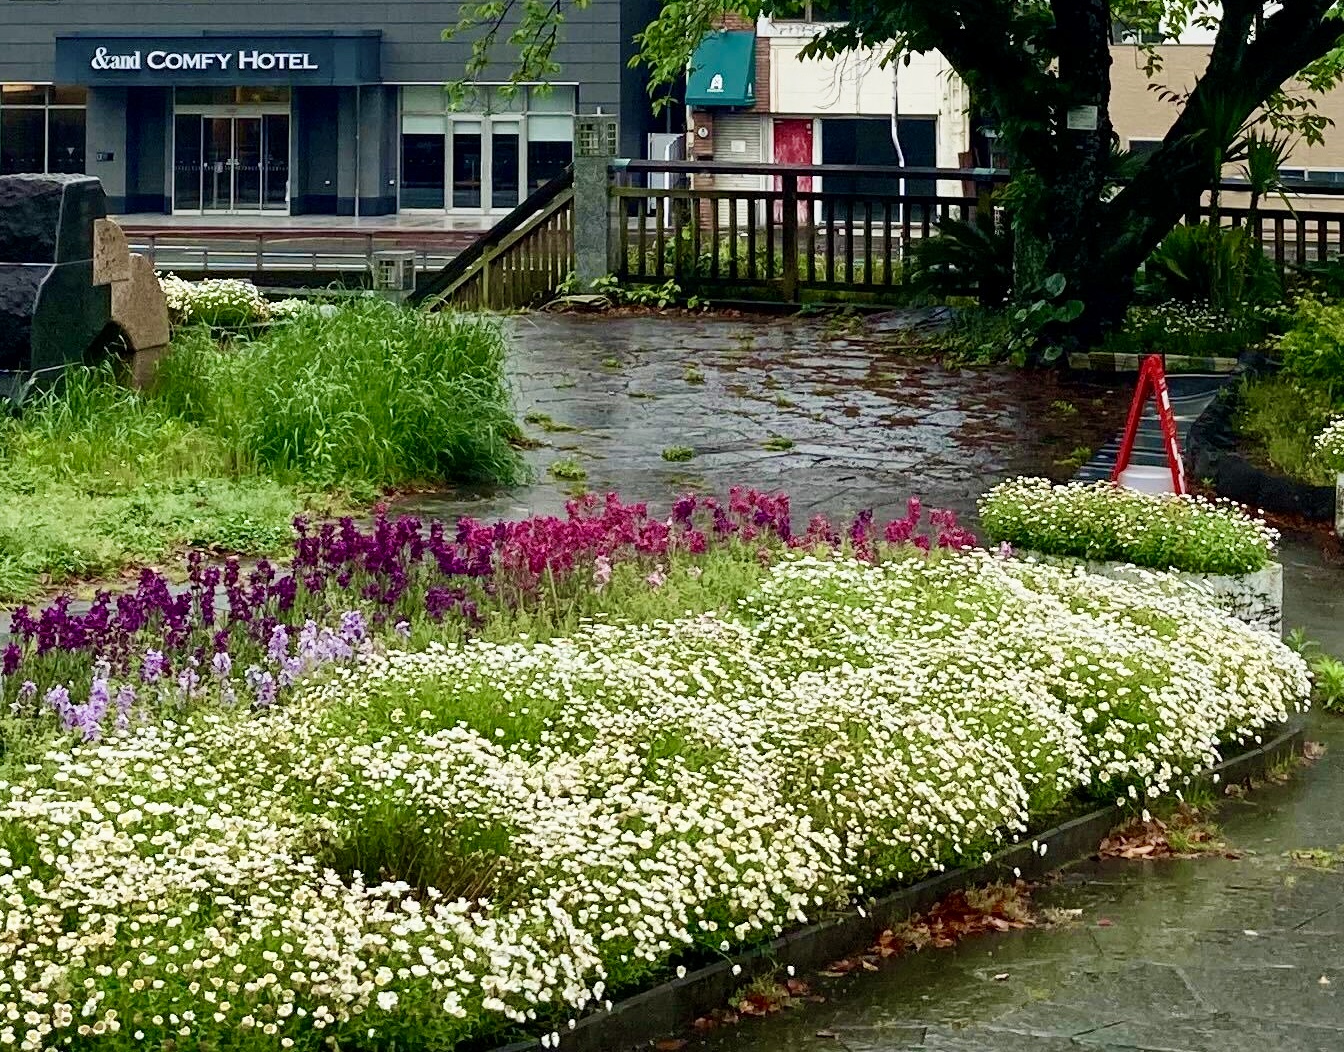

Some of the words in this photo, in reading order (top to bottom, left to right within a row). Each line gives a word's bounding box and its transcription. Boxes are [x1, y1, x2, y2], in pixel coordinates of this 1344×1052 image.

[91, 46, 141, 70] &and
[146, 50, 233, 70] COMFY
[238, 49, 319, 70] HOTEL
